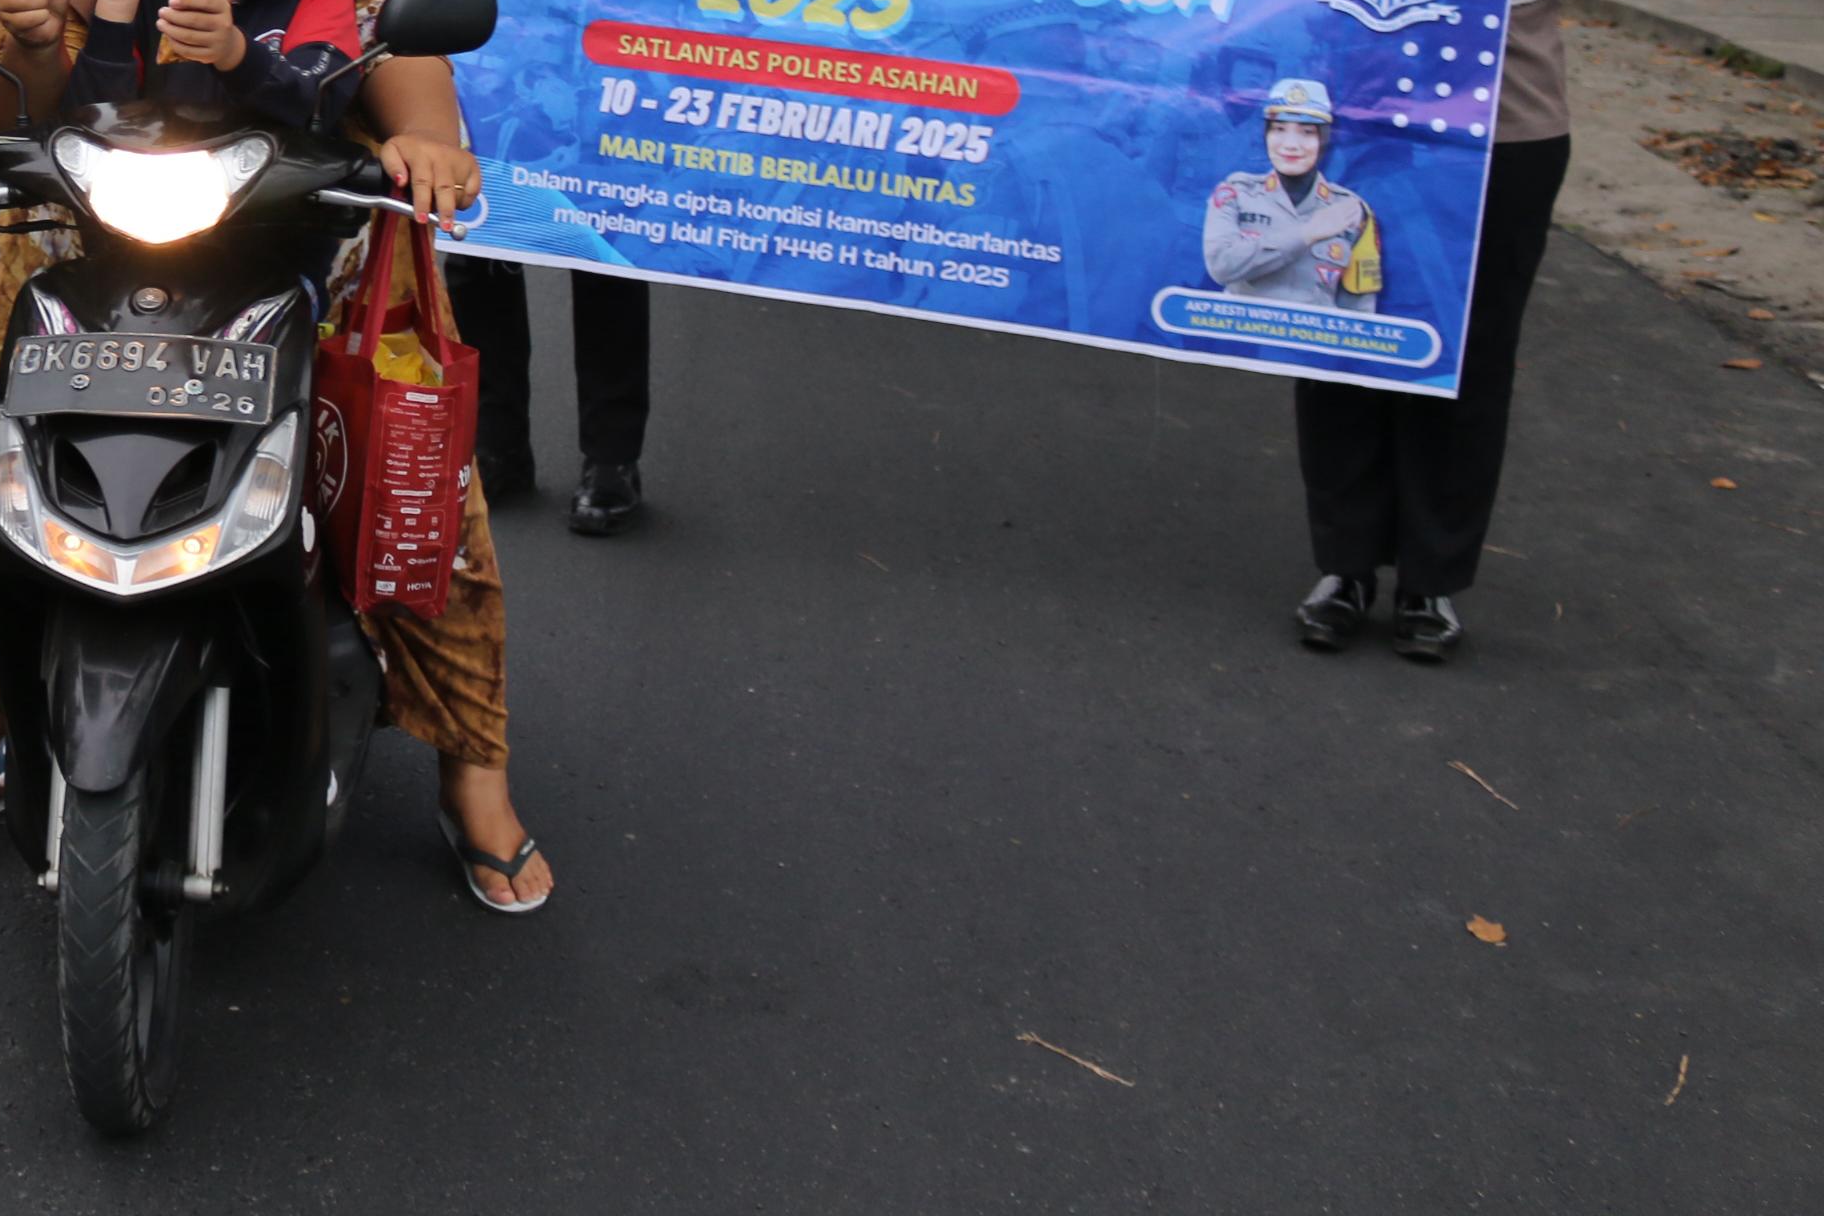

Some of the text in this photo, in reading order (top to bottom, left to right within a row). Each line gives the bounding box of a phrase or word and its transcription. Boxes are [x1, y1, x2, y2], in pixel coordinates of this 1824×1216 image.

[617, 33, 980, 101] SATLANTAS POLRES ASAHAN
[598, 75, 633, 115] 10
[662, 84, 713, 128] 23
[714, 93, 892, 150] FEBRUARI
[893, 115, 995, 166] 2025
[598, 133, 978, 209] MARI TERTIB BERLALU LINTAS
[511, 165, 1063, 264] Dalam rangka cipta kondisi kamseltibcarlantas
[552, 206, 1012, 290] menjelang Idul Fitri 1446 H tahun 2025
[1184, 299, 1213, 314] AKP
[1212, 302, 1248, 319] RESTI
[1247, 307, 1291, 325] WIDYA
[1235, 320, 1288, 337] LANTAS
[1289, 326, 1341, 346] POLRES
[1341, 336, 1401, 354] ASAHAN
[407, 581, 433, 592] HOYA
